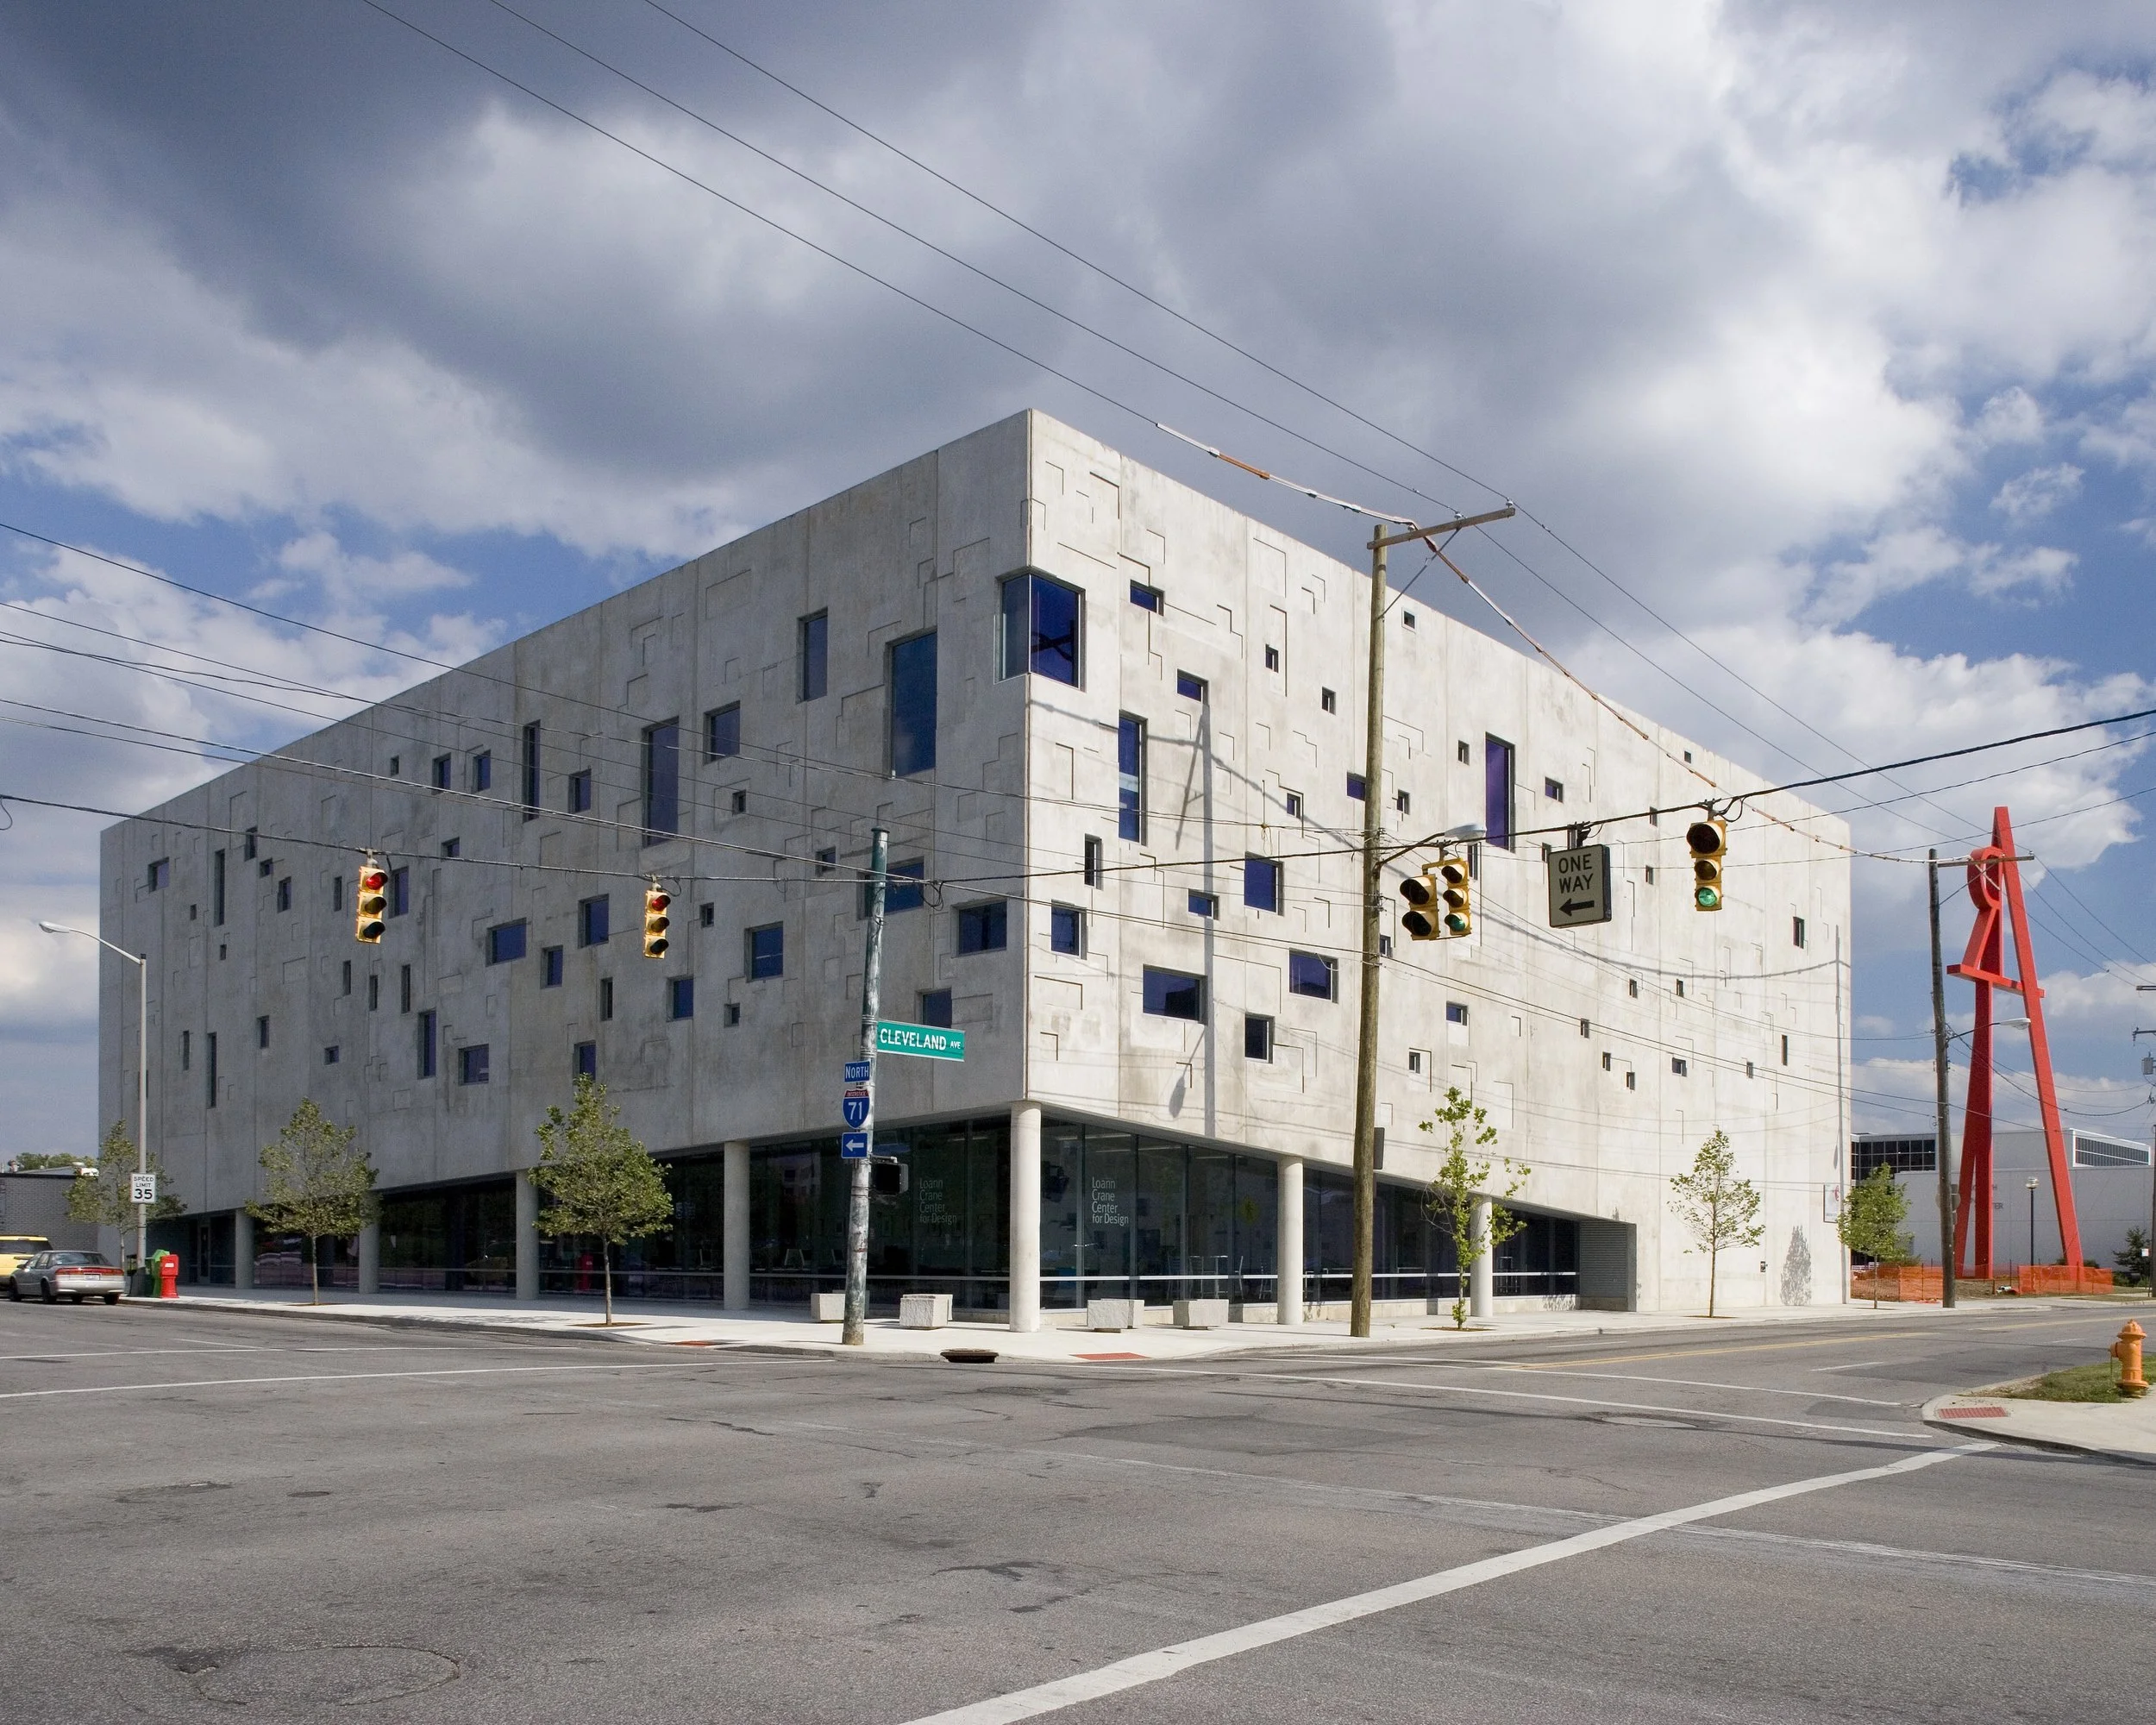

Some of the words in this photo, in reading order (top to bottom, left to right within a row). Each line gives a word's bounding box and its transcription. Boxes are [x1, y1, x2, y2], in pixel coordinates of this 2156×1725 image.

[1558, 854, 1592, 874] ONE
[1559, 874, 1594, 894] WAY
[880, 1028, 947, 1051] CLEVELAND
[950, 1041, 962, 1050] AVE
[845, 1065, 869, 1079] NORTH
[848, 1101, 862, 1120] 71
[919, 1177, 943, 1189] Loann
[1092, 1176, 1116, 1189] Loann
[134, 1189, 153, 1200] 35
[919, 1189, 943, 1201] Crane
[1092, 1189, 1115, 1201] Crane
[919, 1201, 945, 1214] Center
[1092, 1201, 1119, 1214] Center
[919, 1214, 930, 1223] for
[931, 1213, 957, 1226] Design
[1092, 1214, 1102, 1224] for
[1104, 1213, 1129, 1226] Design
